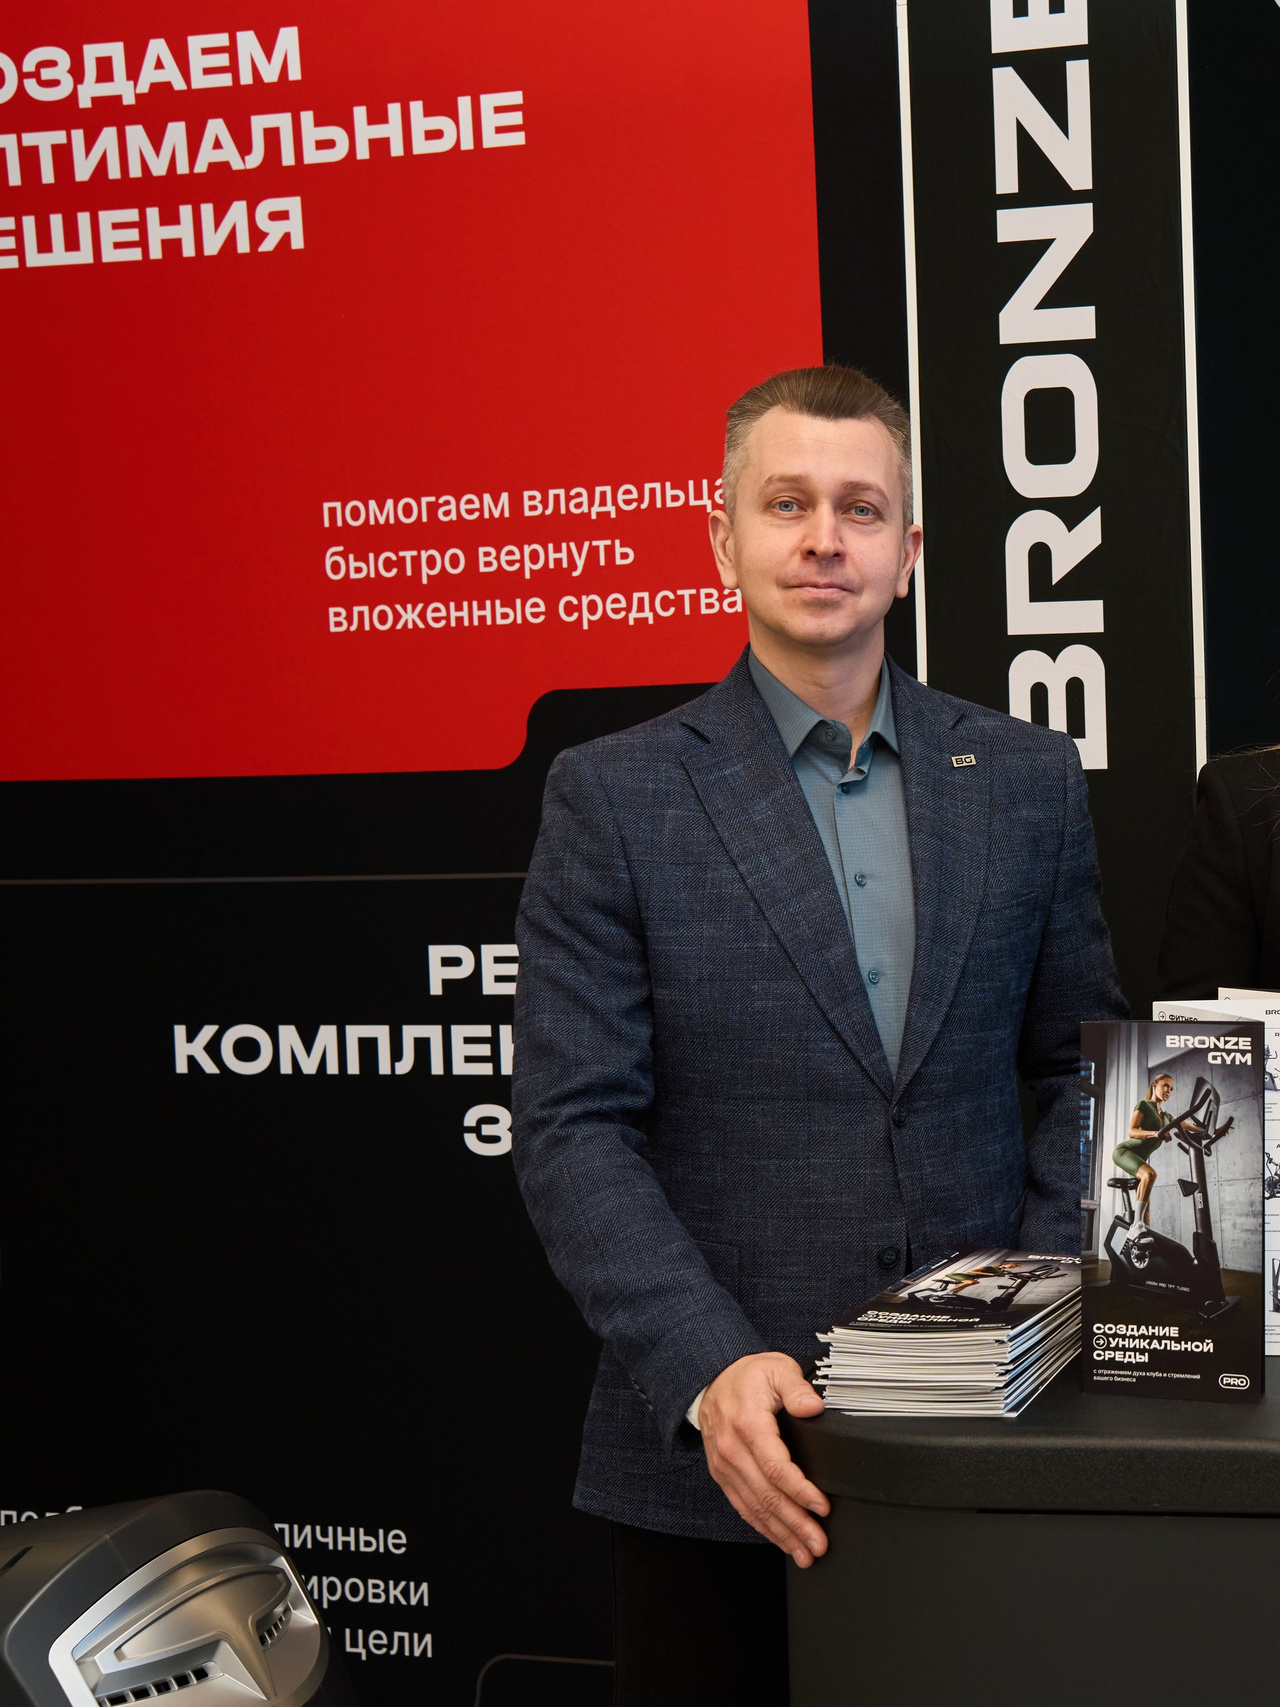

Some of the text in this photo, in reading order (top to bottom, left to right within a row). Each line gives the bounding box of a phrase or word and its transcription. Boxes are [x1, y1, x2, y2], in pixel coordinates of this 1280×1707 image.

[322, 492, 510, 529] помогаем
[324, 538, 635, 584] быстро вернуть
[328, 586, 744, 633] вложенные средства
[955, 756, 973, 766] BG
[427, 943, 520, 996] РЕ
[1165, 1034, 1252, 1050] BRONZE
[1207, 1051, 1252, 1066] GYM
[1092, 1323, 1180, 1338] СОЗДАНИЕ
[1109, 1337, 1214, 1353] УНИКАЛЬНОЙ
[1092, 1350, 1149, 1364] СРЕДЫ
[1113, 1375, 1137, 1383] бизнеса
[1222, 1376, 1247, 1387] PRO
[345, 1628, 433, 1661] цели
